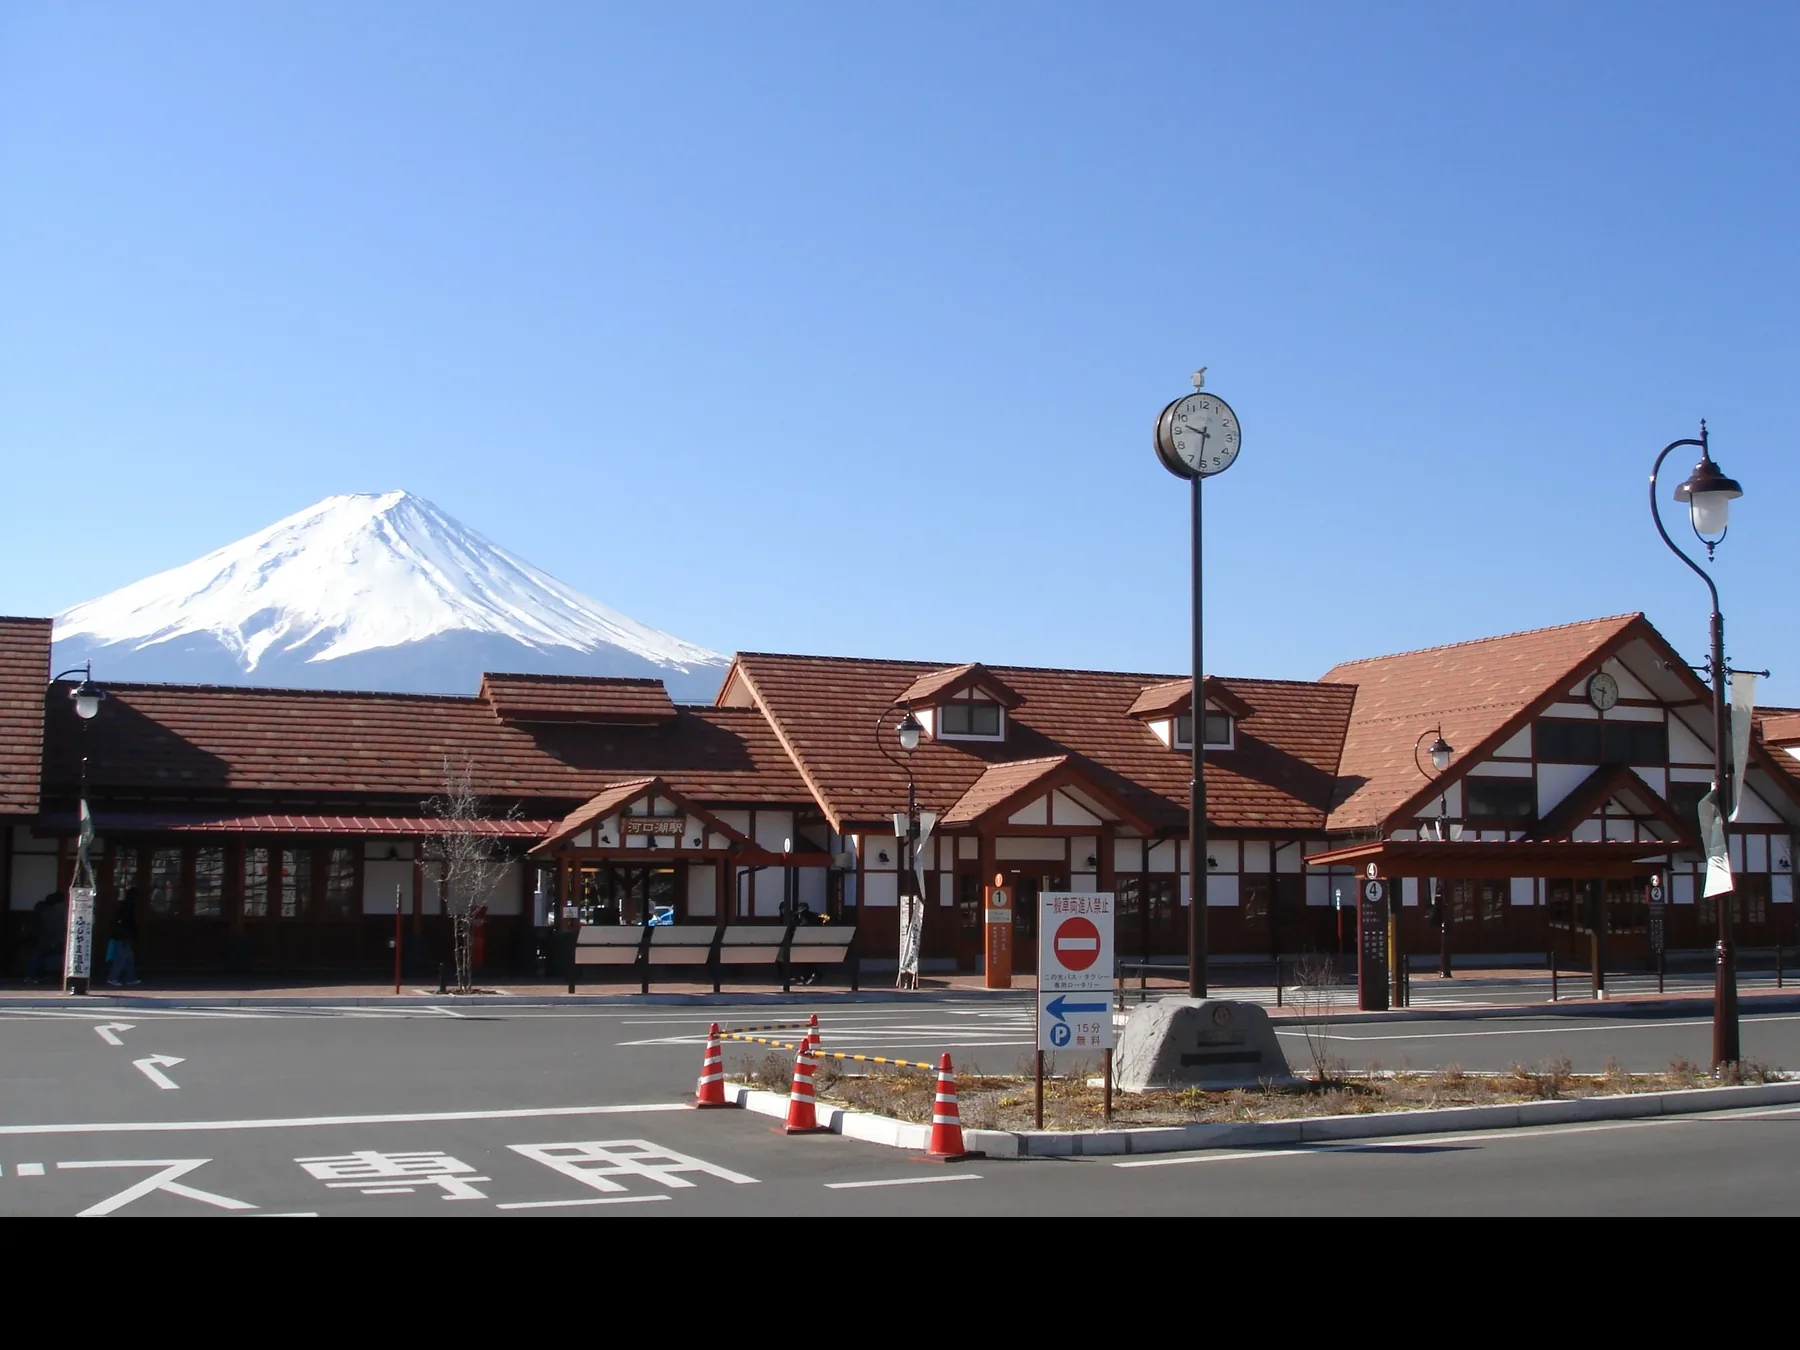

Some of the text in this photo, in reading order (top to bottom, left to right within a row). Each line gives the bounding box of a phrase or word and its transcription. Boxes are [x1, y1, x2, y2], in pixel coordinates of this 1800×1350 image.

[1186, 403, 1196, 413] 11
[1199, 400, 1210, 410] 12
[1177, 413, 1188, 423] 10
[1222, 418, 1230, 428] 2
[1174, 426, 1183, 436] 9
[1225, 433, 1233, 443] 3
[1177, 440, 1186, 450] 8
[1221, 447, 1230, 455] 4
[1187, 454, 1195, 463] 7
[1212, 457, 1221, 466] 5
[1200, 460, 1208, 469] 6
[627, 822, 683, 834] 河口湖駅
[1369, 882, 1378, 897] 4
[1653, 888, 1660, 898] 2
[995, 890, 1002, 903] 1
[1046, 896, 1109, 914] 一般車両進入禁止
[1076, 1022, 1101, 1034] 15分
[1055, 1026, 1068, 1045] P
[1076, 1035, 1101, 1047] 無料
